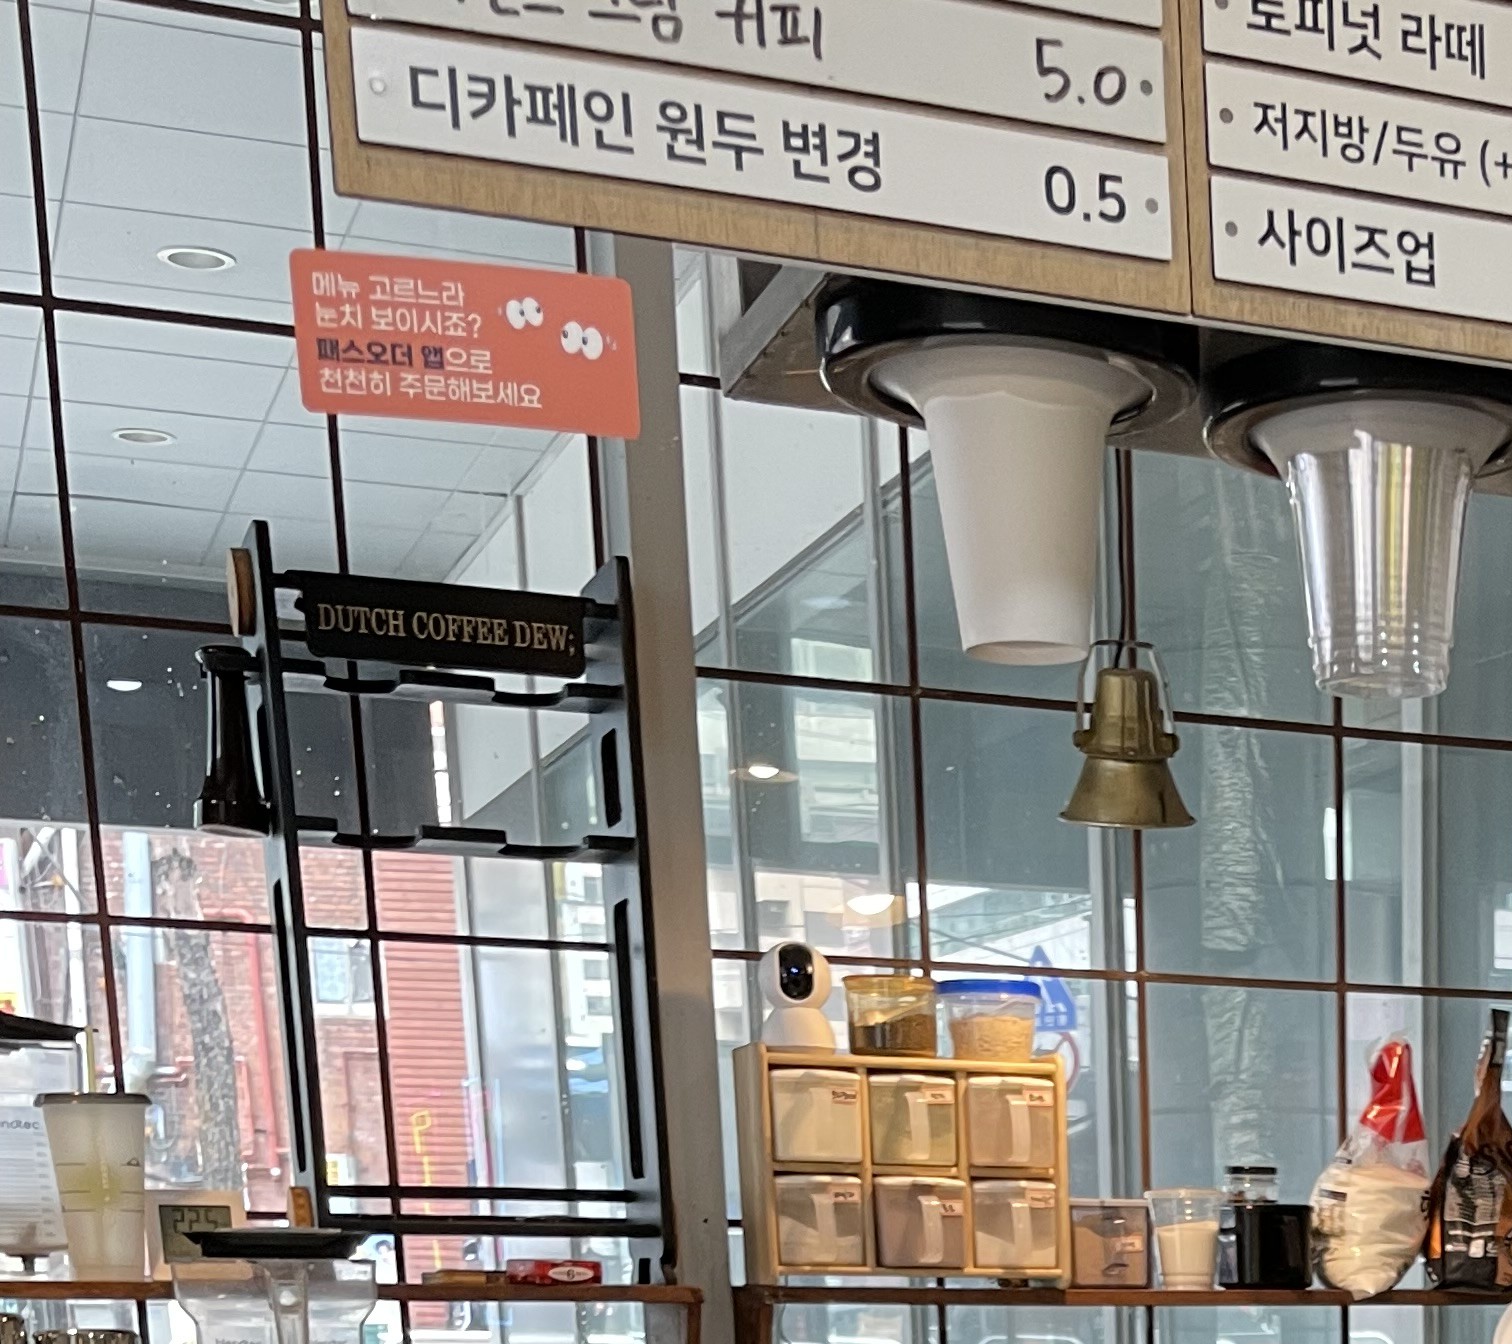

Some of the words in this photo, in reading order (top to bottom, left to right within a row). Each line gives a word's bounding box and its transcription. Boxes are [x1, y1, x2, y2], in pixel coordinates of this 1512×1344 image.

[1033, 38, 1125, 108] 5.0
[1401, 13, 1486, 80] 라떼
[409, 65, 634, 154] 디카페인
[656, 99, 765, 172] 원두
[781, 120, 882, 194] 변경
[1043, 165, 1127, 226] 0.5
[1252, 101, 1467, 182] 저지방/두유
[1257, 207, 1438, 289] 사이즈업
[312, 272, 361, 298] 메뉴
[369, 275, 465, 307] 고르느라
[315, 302, 362, 330] 눈치
[371, 305, 483, 339] 보이시죠?
[317, 338, 413, 368] 패스오더
[421, 345, 493, 374] 앱으로
[320, 369, 391, 396] 천천히
[400, 375, 543, 409] 주문해보세요
[317, 603, 406, 637] DUTCH
[412, 611, 509, 646] COFFEE
